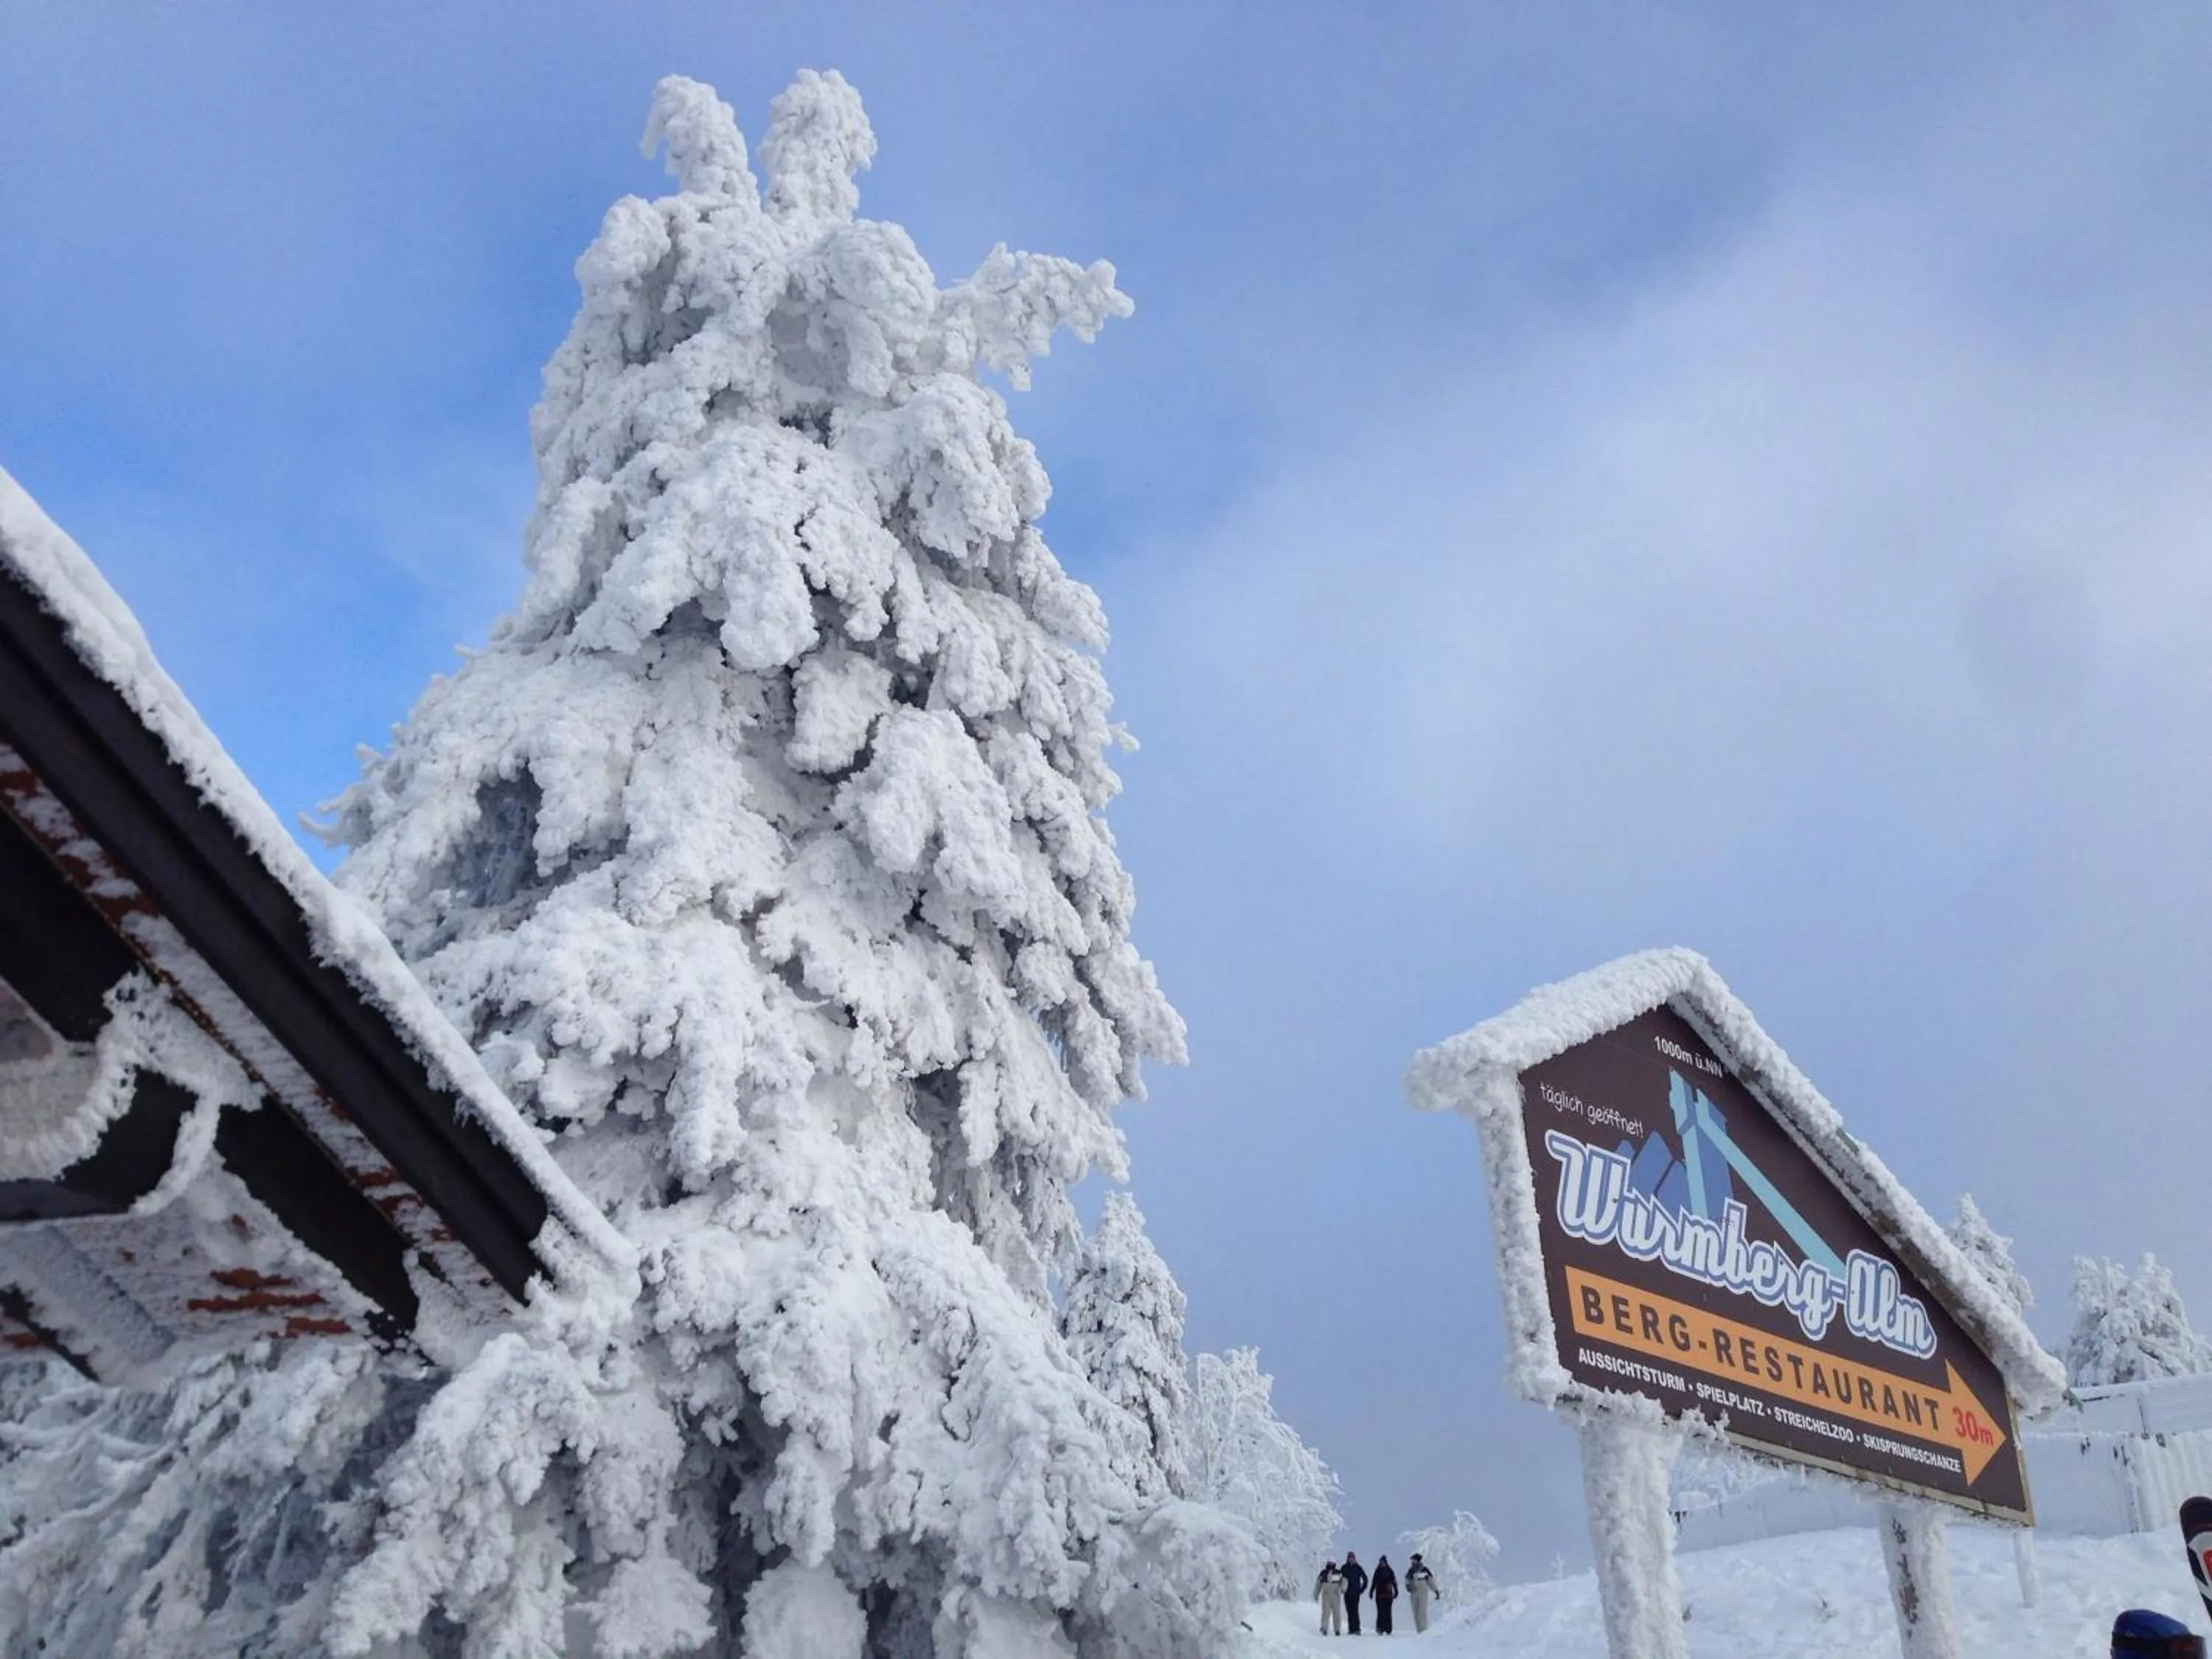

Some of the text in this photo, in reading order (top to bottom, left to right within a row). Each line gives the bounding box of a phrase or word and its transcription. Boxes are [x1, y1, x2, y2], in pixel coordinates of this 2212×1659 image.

[1654, 1035, 1694, 1065] 1000m
[1540, 1082, 1644, 1138] täglich geöffnet!
[1545, 1129, 1936, 1359] Wurmberg-Alm
[1581, 1284, 1939, 1430] BERG-RESTAURANT
[1579, 1347, 1962, 1473] AUSSICHTSTURM SPIELPLATZ STREICHELZOO SKISPRUNGSCHANZE
[1952, 1406, 1994, 1446] 30m
